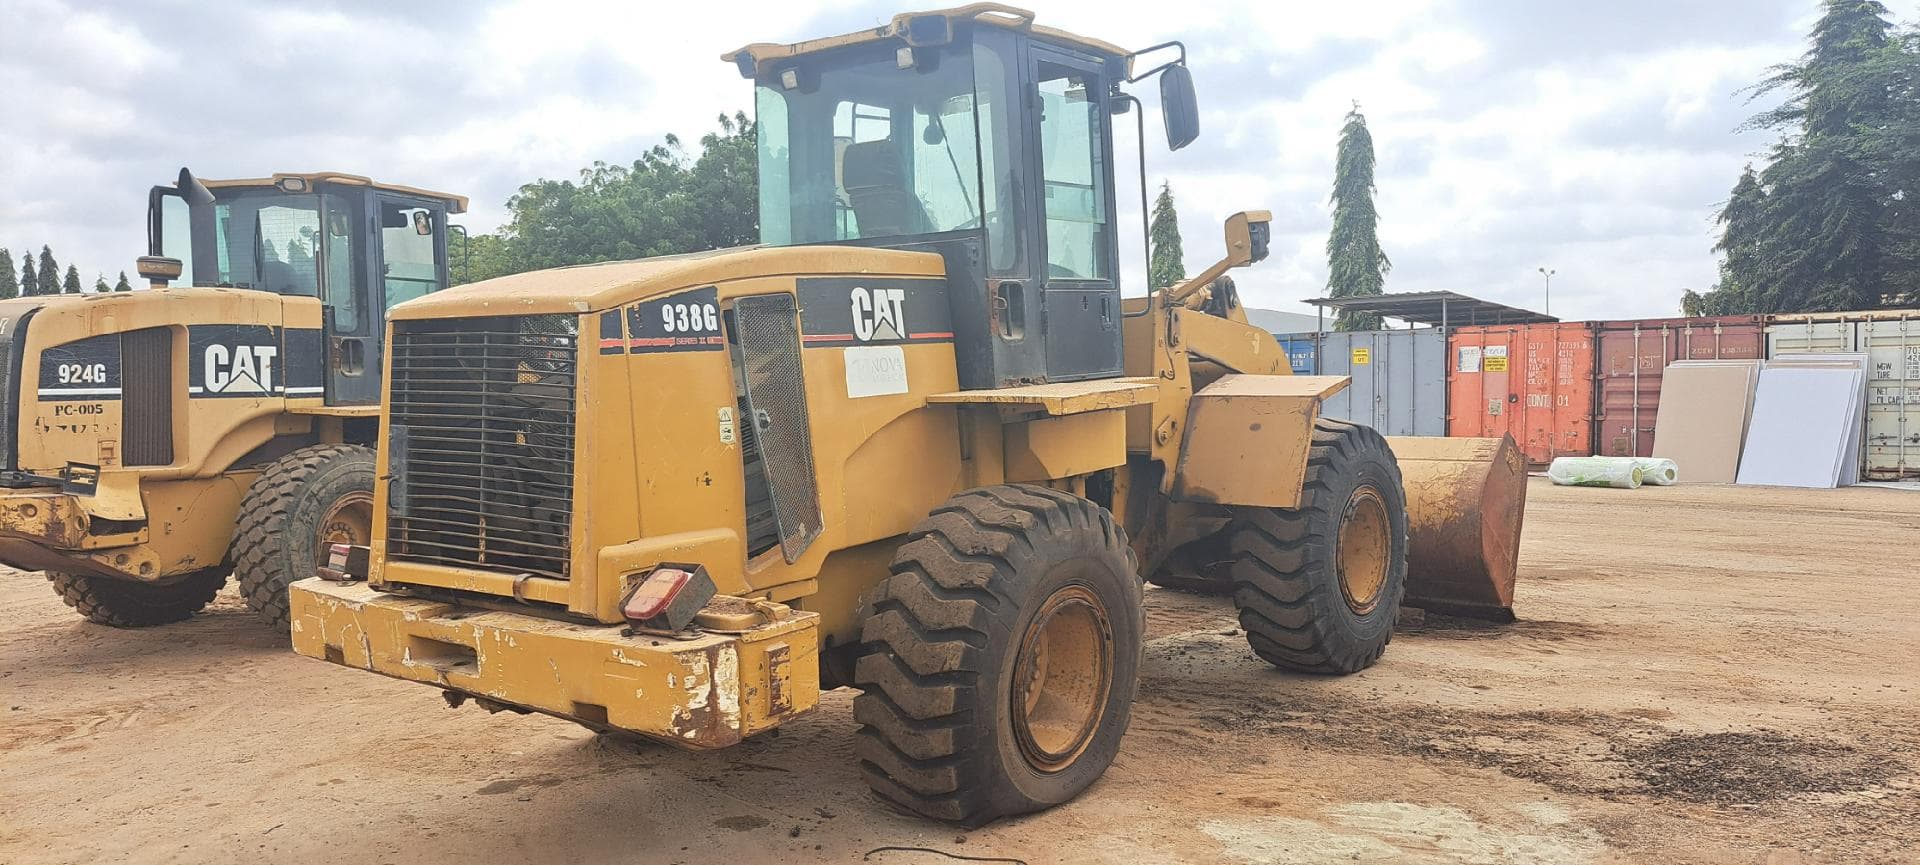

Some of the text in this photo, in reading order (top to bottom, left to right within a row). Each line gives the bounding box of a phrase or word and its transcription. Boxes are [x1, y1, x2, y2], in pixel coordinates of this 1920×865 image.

[662, 304, 718, 332] 938G
[851, 287, 906, 341] CAT
[58, 364, 106, 383] 924G
[204, 344, 277, 393] CAT
[55, 404, 103, 416] PC-005
[1557, 394, 1569, 407] 01
